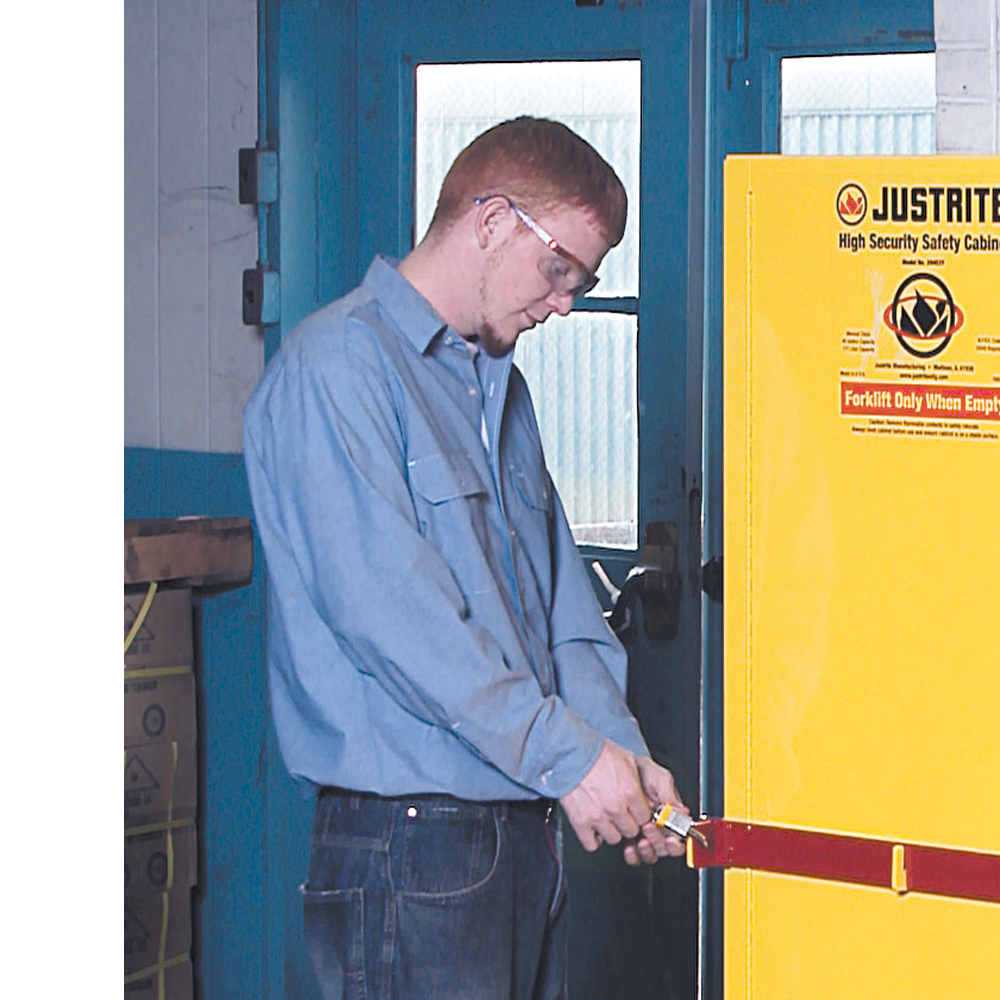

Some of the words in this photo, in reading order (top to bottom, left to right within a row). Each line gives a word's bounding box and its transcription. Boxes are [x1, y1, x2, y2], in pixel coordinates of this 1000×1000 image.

[839, 233, 866, 252] High
[869, 233, 918, 253] Security
[922, 233, 961, 253] Safety
[845, 389, 892, 409] Forklift
[894, 391, 923, 412] Only
[925, 393, 961, 411] When
